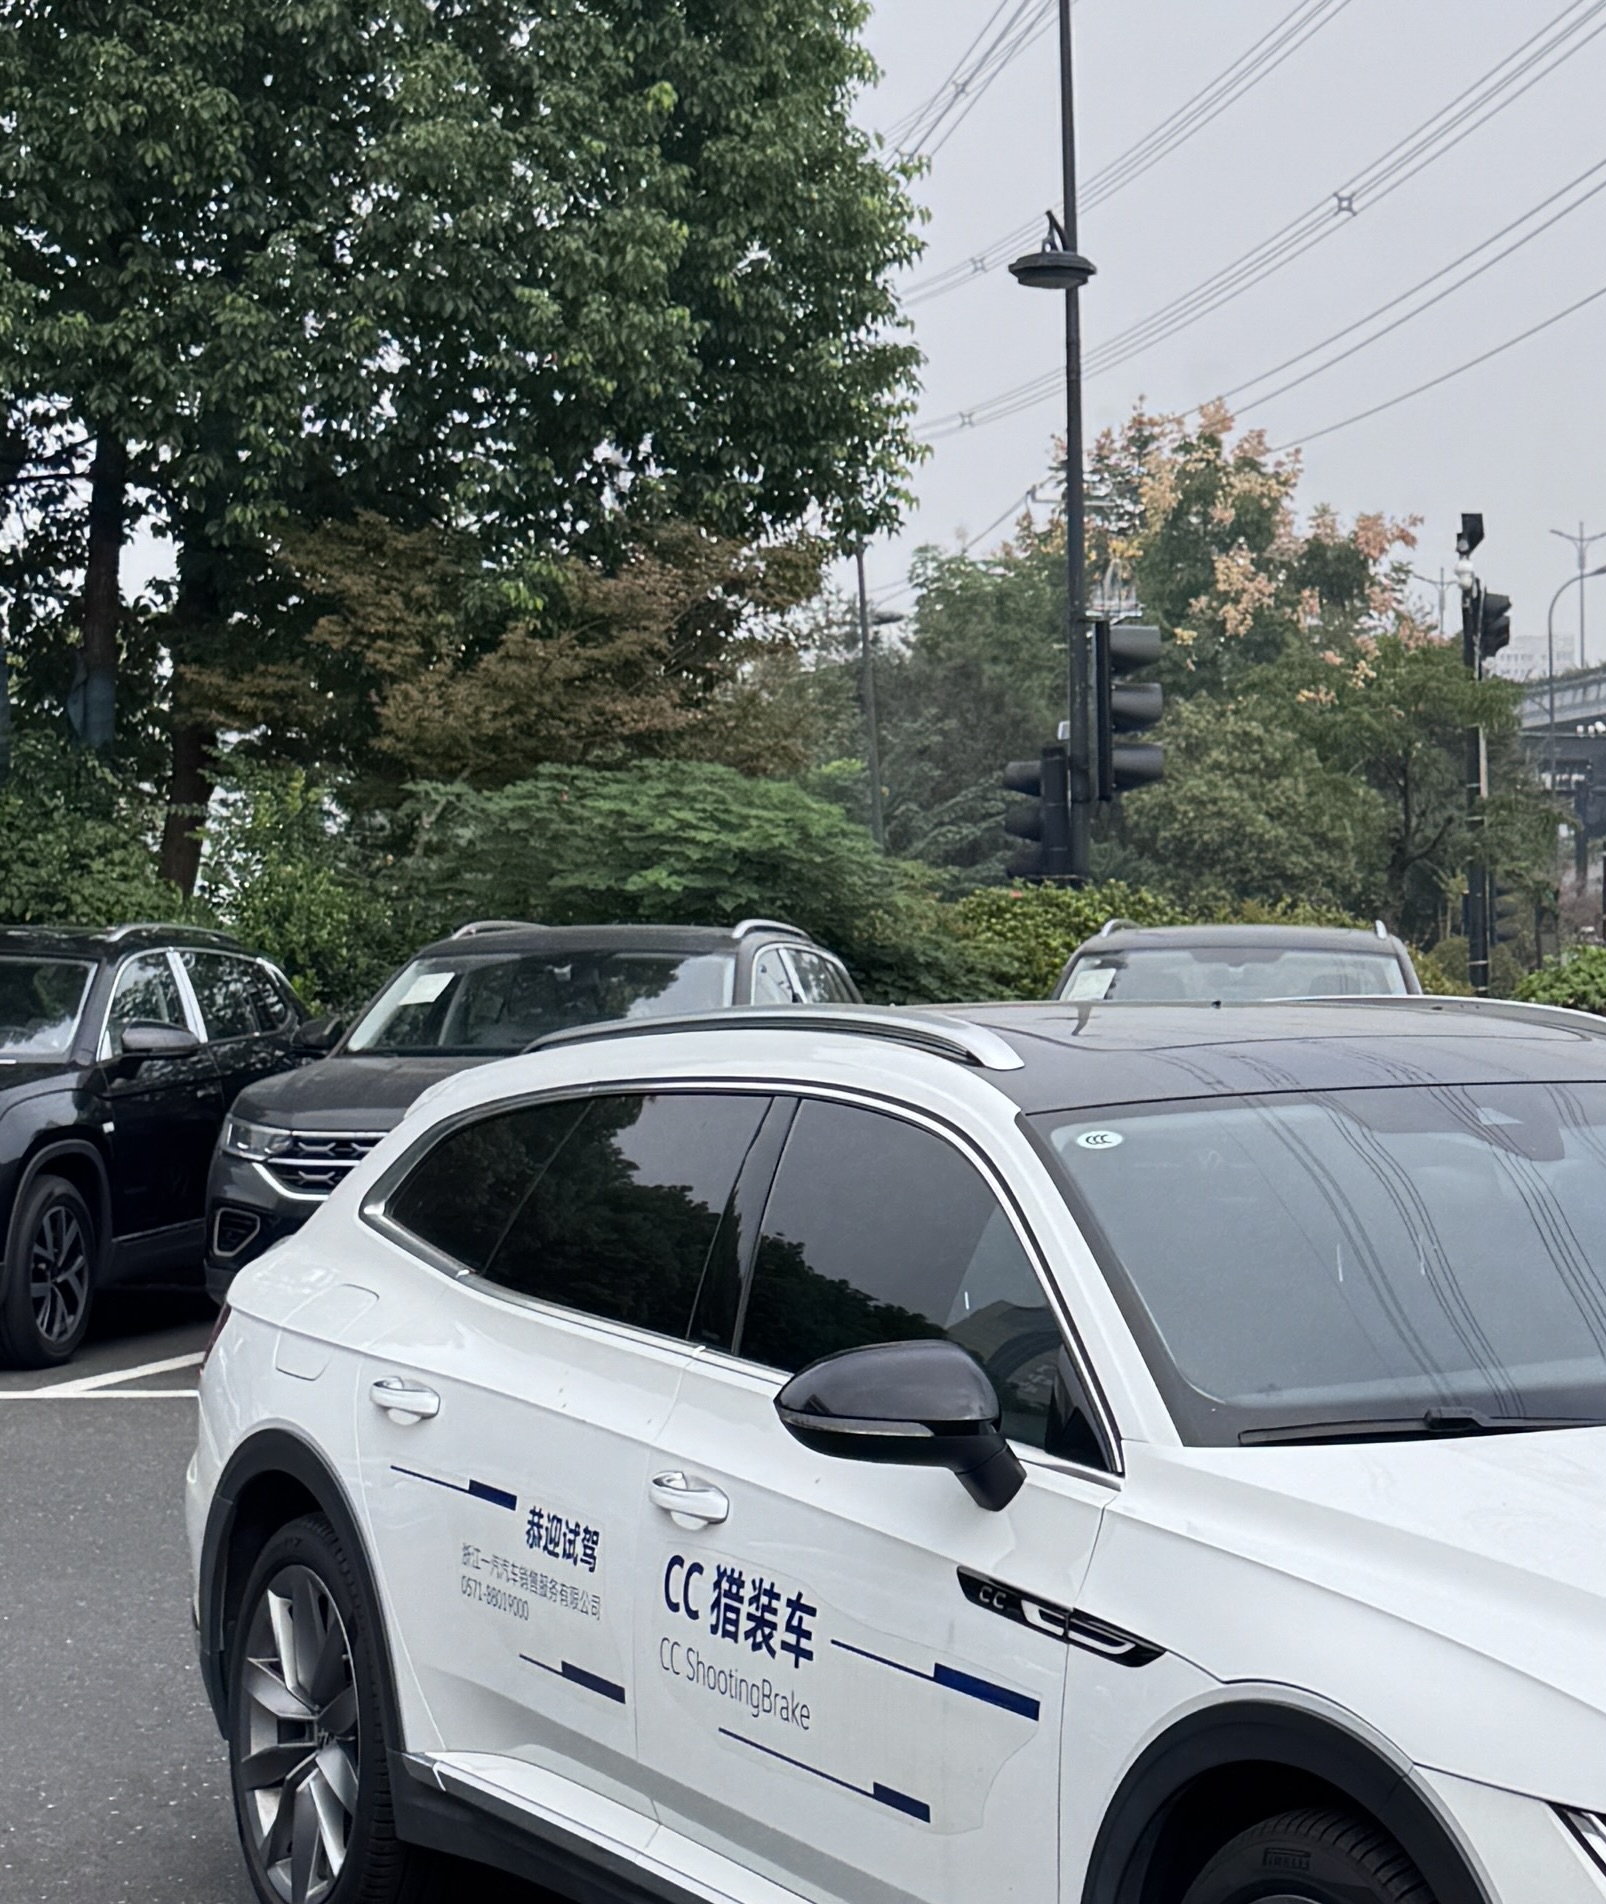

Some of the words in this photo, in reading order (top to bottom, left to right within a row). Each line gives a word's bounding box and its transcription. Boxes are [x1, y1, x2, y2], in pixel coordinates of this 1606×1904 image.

[525, 1505, 600, 1573] 恭迎试驾
[664, 1554, 704, 1621] CC
[710, 1563, 817, 1669] 猎装车
[979, 1585, 1007, 1610] CC
[660, 1636, 681, 1675] CC
[686, 1647, 811, 1730] ShootingBrake
